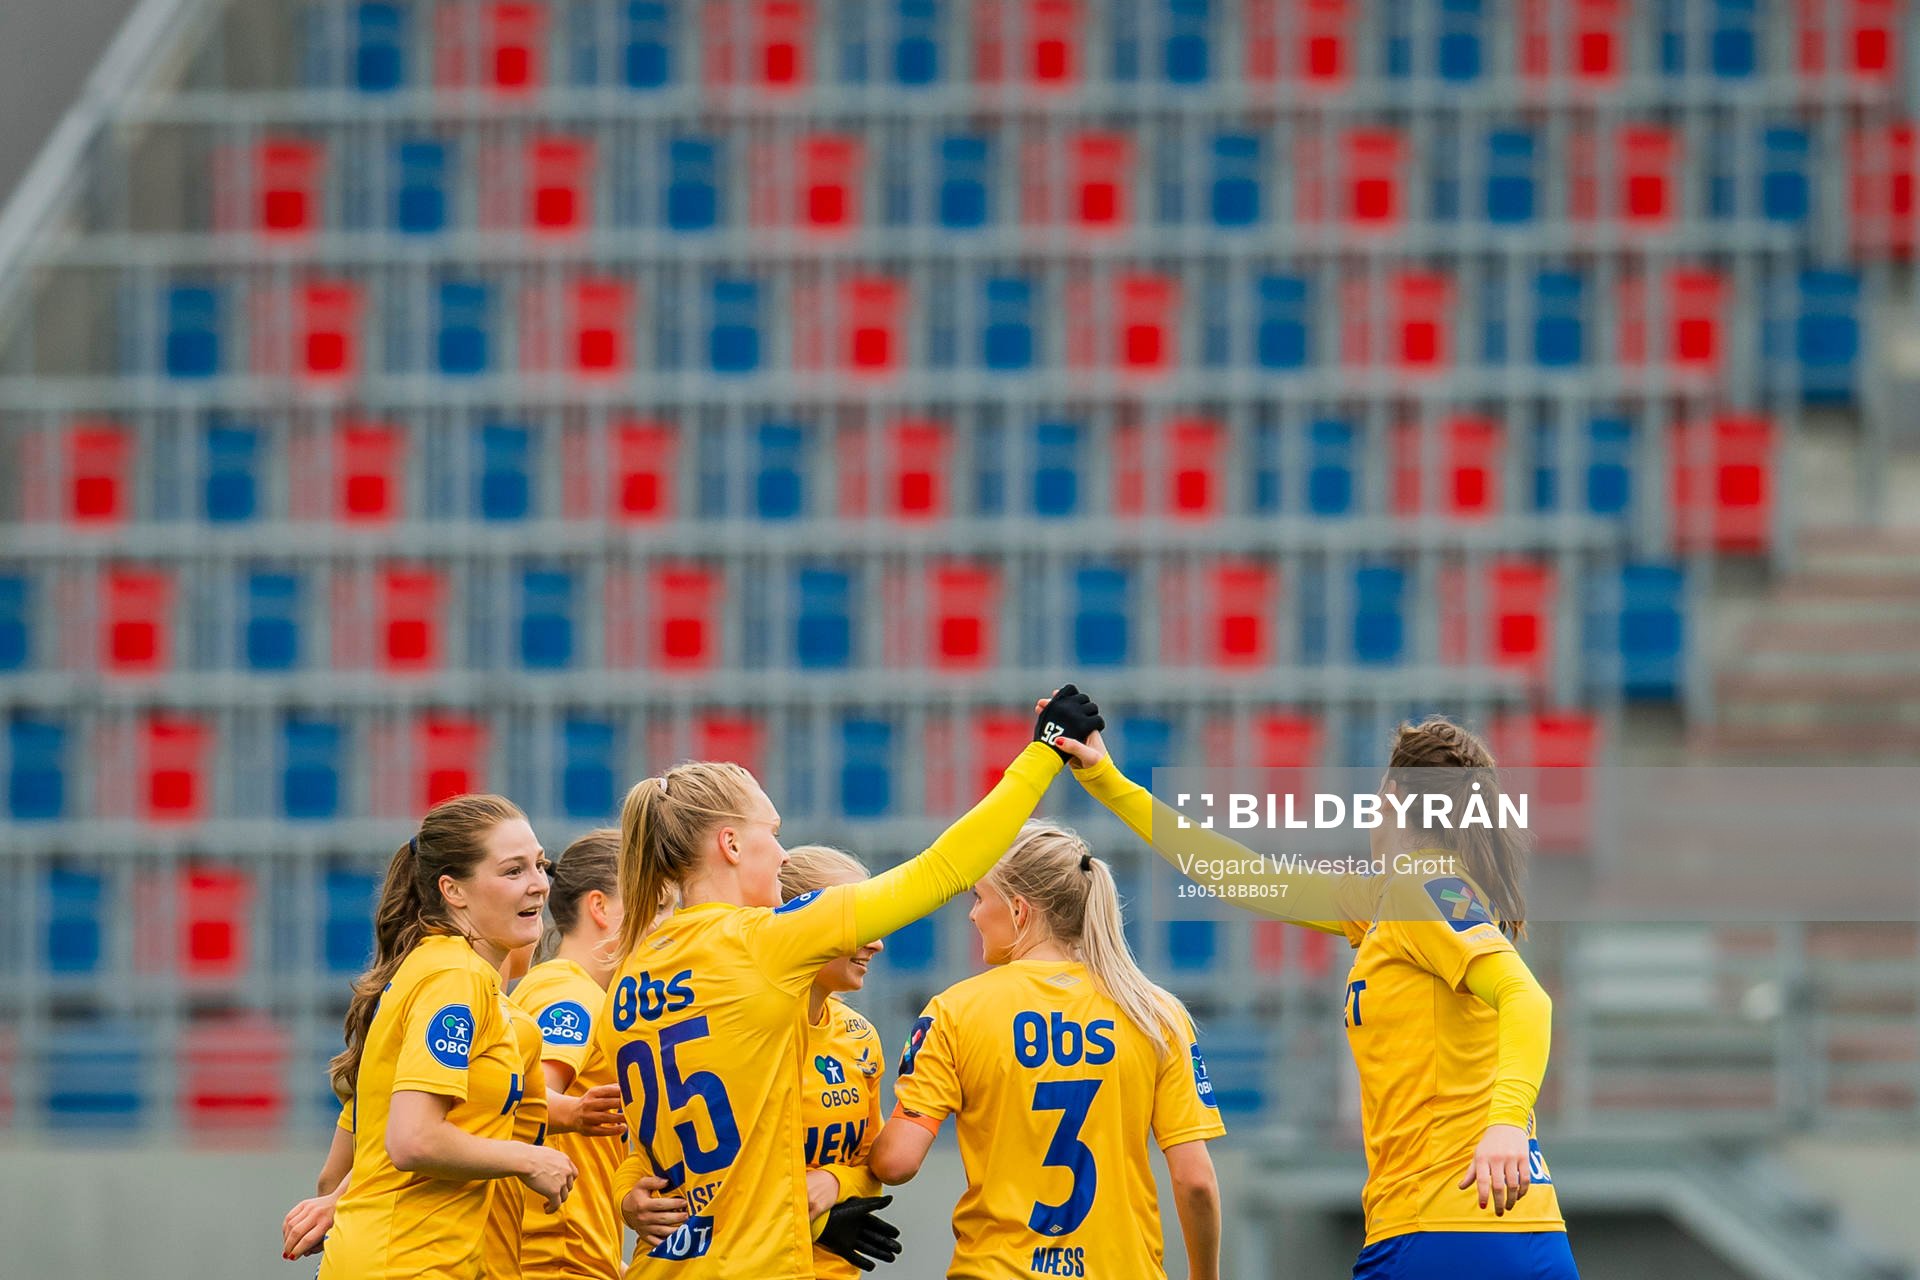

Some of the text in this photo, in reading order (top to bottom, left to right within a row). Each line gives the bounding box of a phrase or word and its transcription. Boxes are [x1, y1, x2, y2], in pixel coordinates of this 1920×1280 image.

[613, 969, 695, 1032] Obs
[435, 1038, 470, 1057] OBO
[541, 1026, 584, 1041] OBOS
[1013, 1011, 1115, 1068] Obs
[617, 1016, 742, 1191] 25
[821, 1088, 860, 1109] OBOS
[1028, 1079, 1104, 1237] 3
[1031, 1247, 1085, 1278] NÆSS
